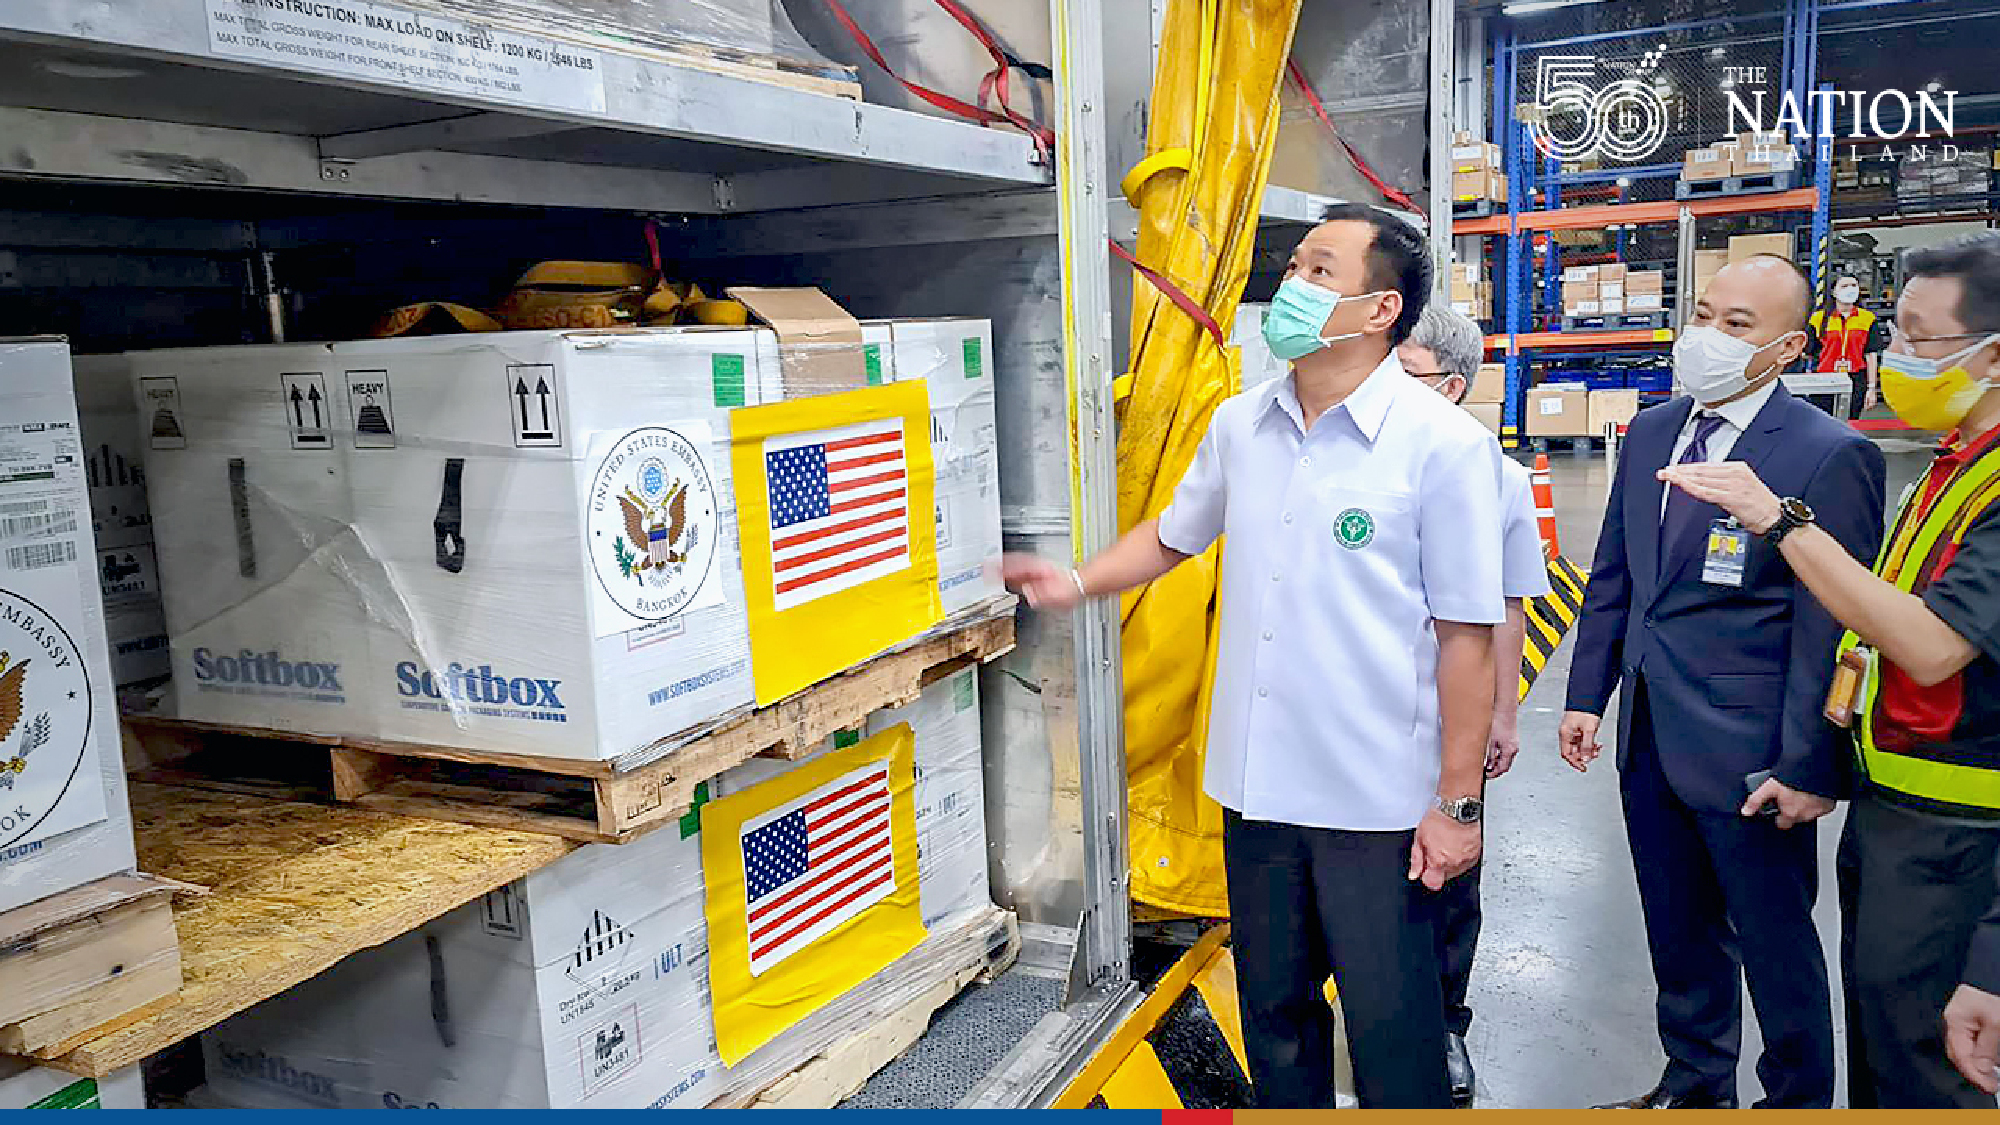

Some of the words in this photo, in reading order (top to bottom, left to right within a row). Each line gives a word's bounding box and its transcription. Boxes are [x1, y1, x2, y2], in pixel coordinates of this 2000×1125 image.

[213, 11, 236, 23] MAX
[216, 31, 239, 45] MAX
[364, 14, 394, 31] MAX
[397, 21, 432, 39] LOAD
[435, 29, 453, 43] ON
[501, 42, 524, 58] 1200
[527, 47, 542, 61] KG
[574, 55, 594, 70] LBS
[352, 382, 384, 395] HEAVY
[594, 453, 625, 512] UNITED
[627, 435, 668, 456] STATES
[669, 440, 708, 493] EMBASSY
[636, 586, 688, 613] BANGKOK
[0, 602, 71, 669] MBASSY
[193, 647, 344, 691] Softbox
[396, 661, 567, 709] Softbox
[661, 943, 684, 974] ULT
[594, 1046, 629, 1078] UN3481
